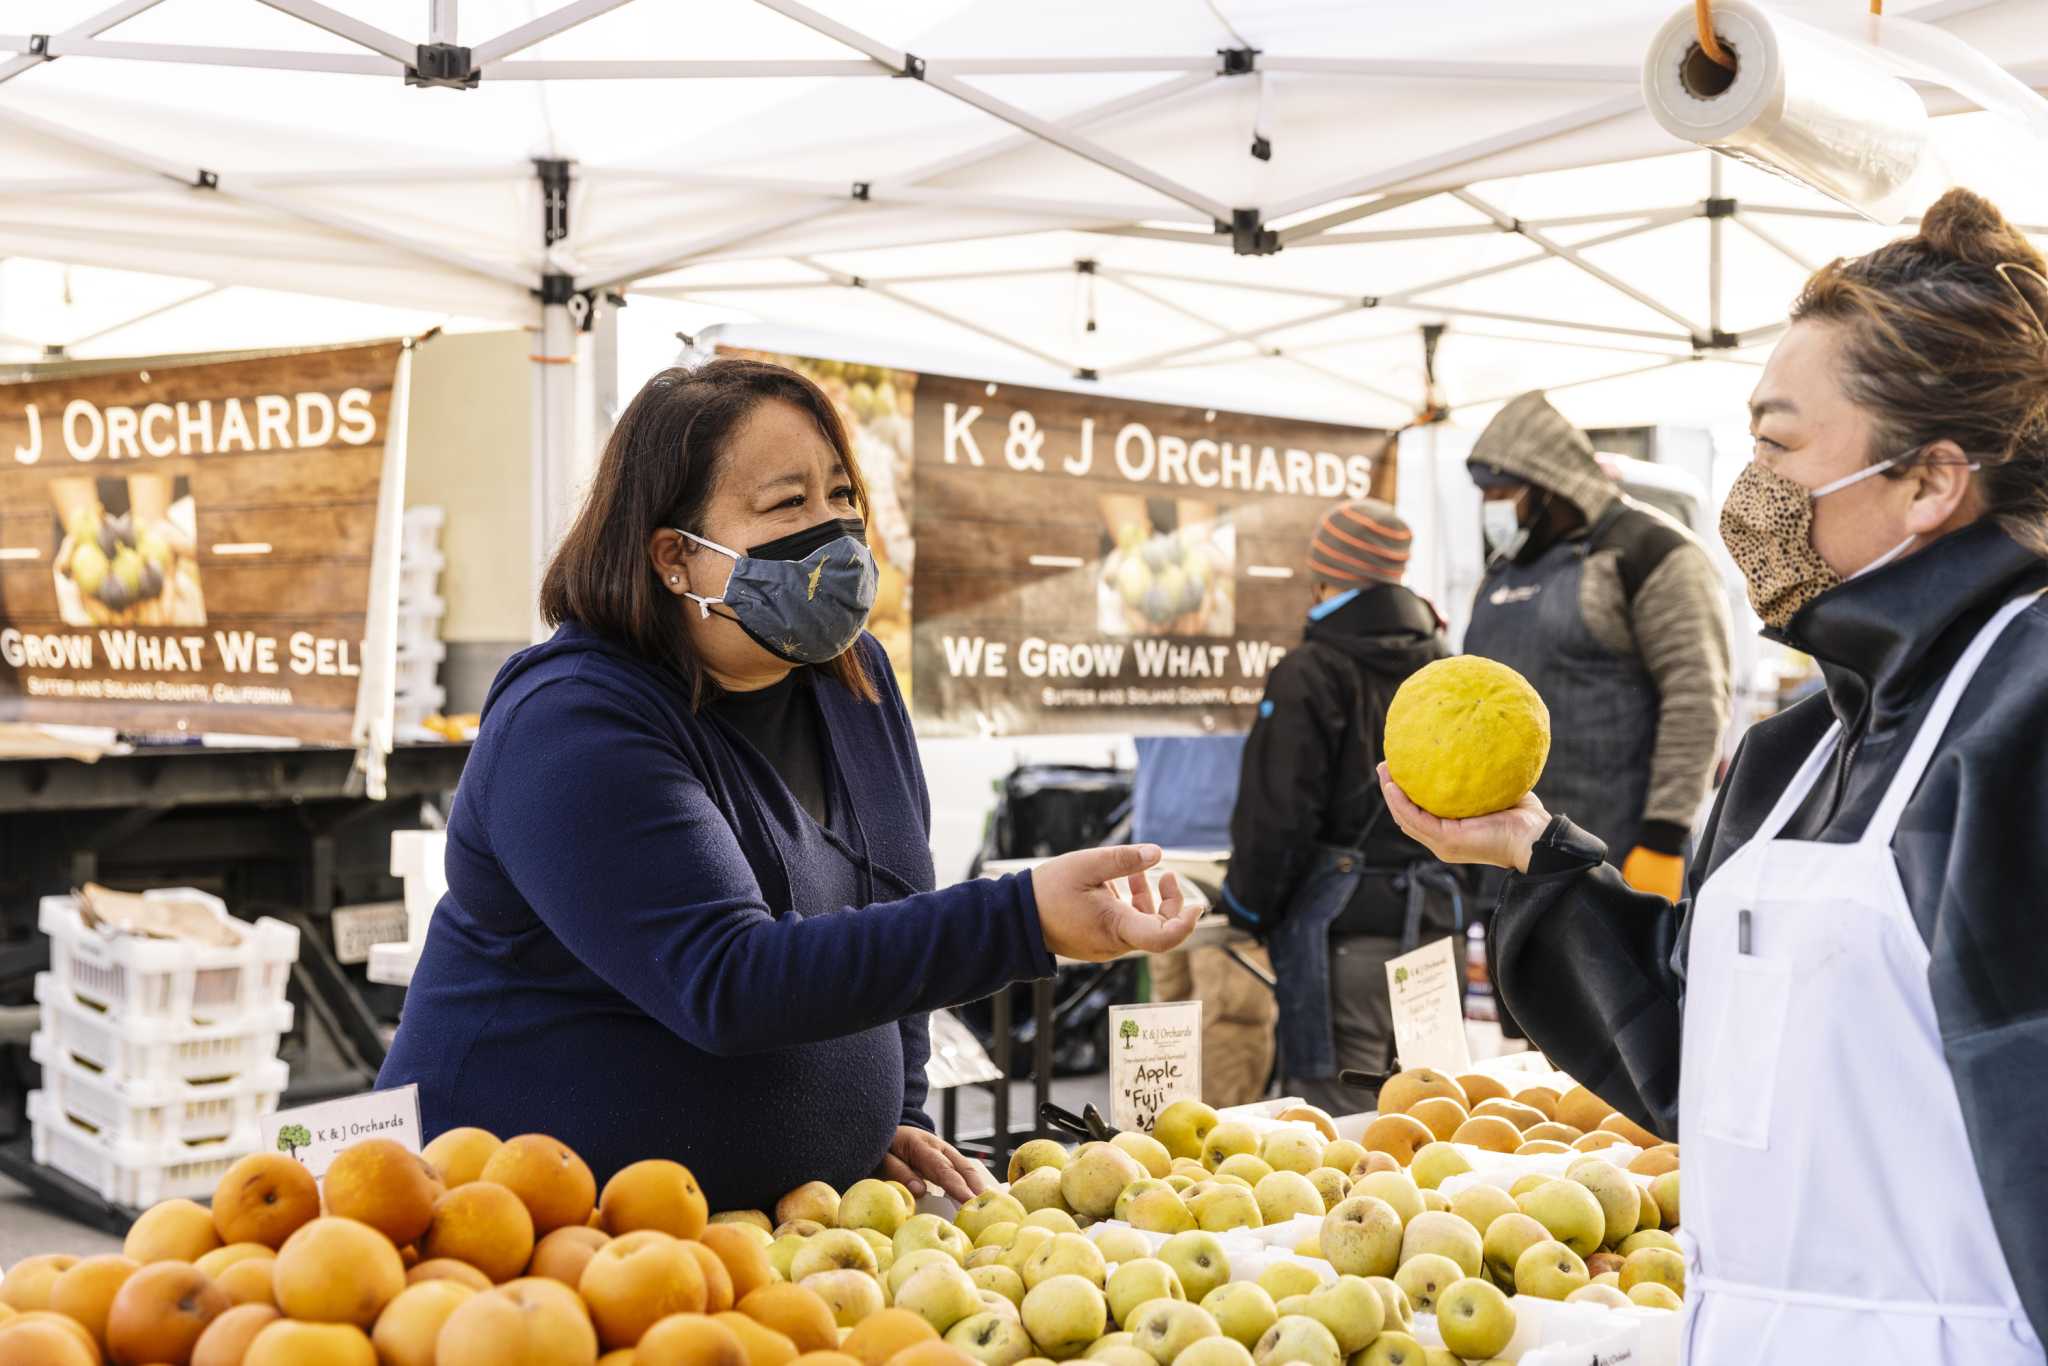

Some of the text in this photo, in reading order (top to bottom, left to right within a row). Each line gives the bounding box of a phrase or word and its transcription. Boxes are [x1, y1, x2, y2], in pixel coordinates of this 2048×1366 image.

[14, 387, 377, 465] J ORCHARDS
[943, 402, 1372, 499] K & J ORCHARDS
[0, 628, 93, 669] GROW
[99, 629, 206, 672] WHAT
[213, 630, 280, 674] WE
[942, 636, 1008, 677] WE
[1018, 637, 1125, 678] GROW
[1133, 639, 1230, 678] WHAT
[1135, 1060, 1183, 1085] Apple
[1125, 1081, 1173, 1113] "Fuji"
[317, 1114, 405, 1143] K & J Orchards
